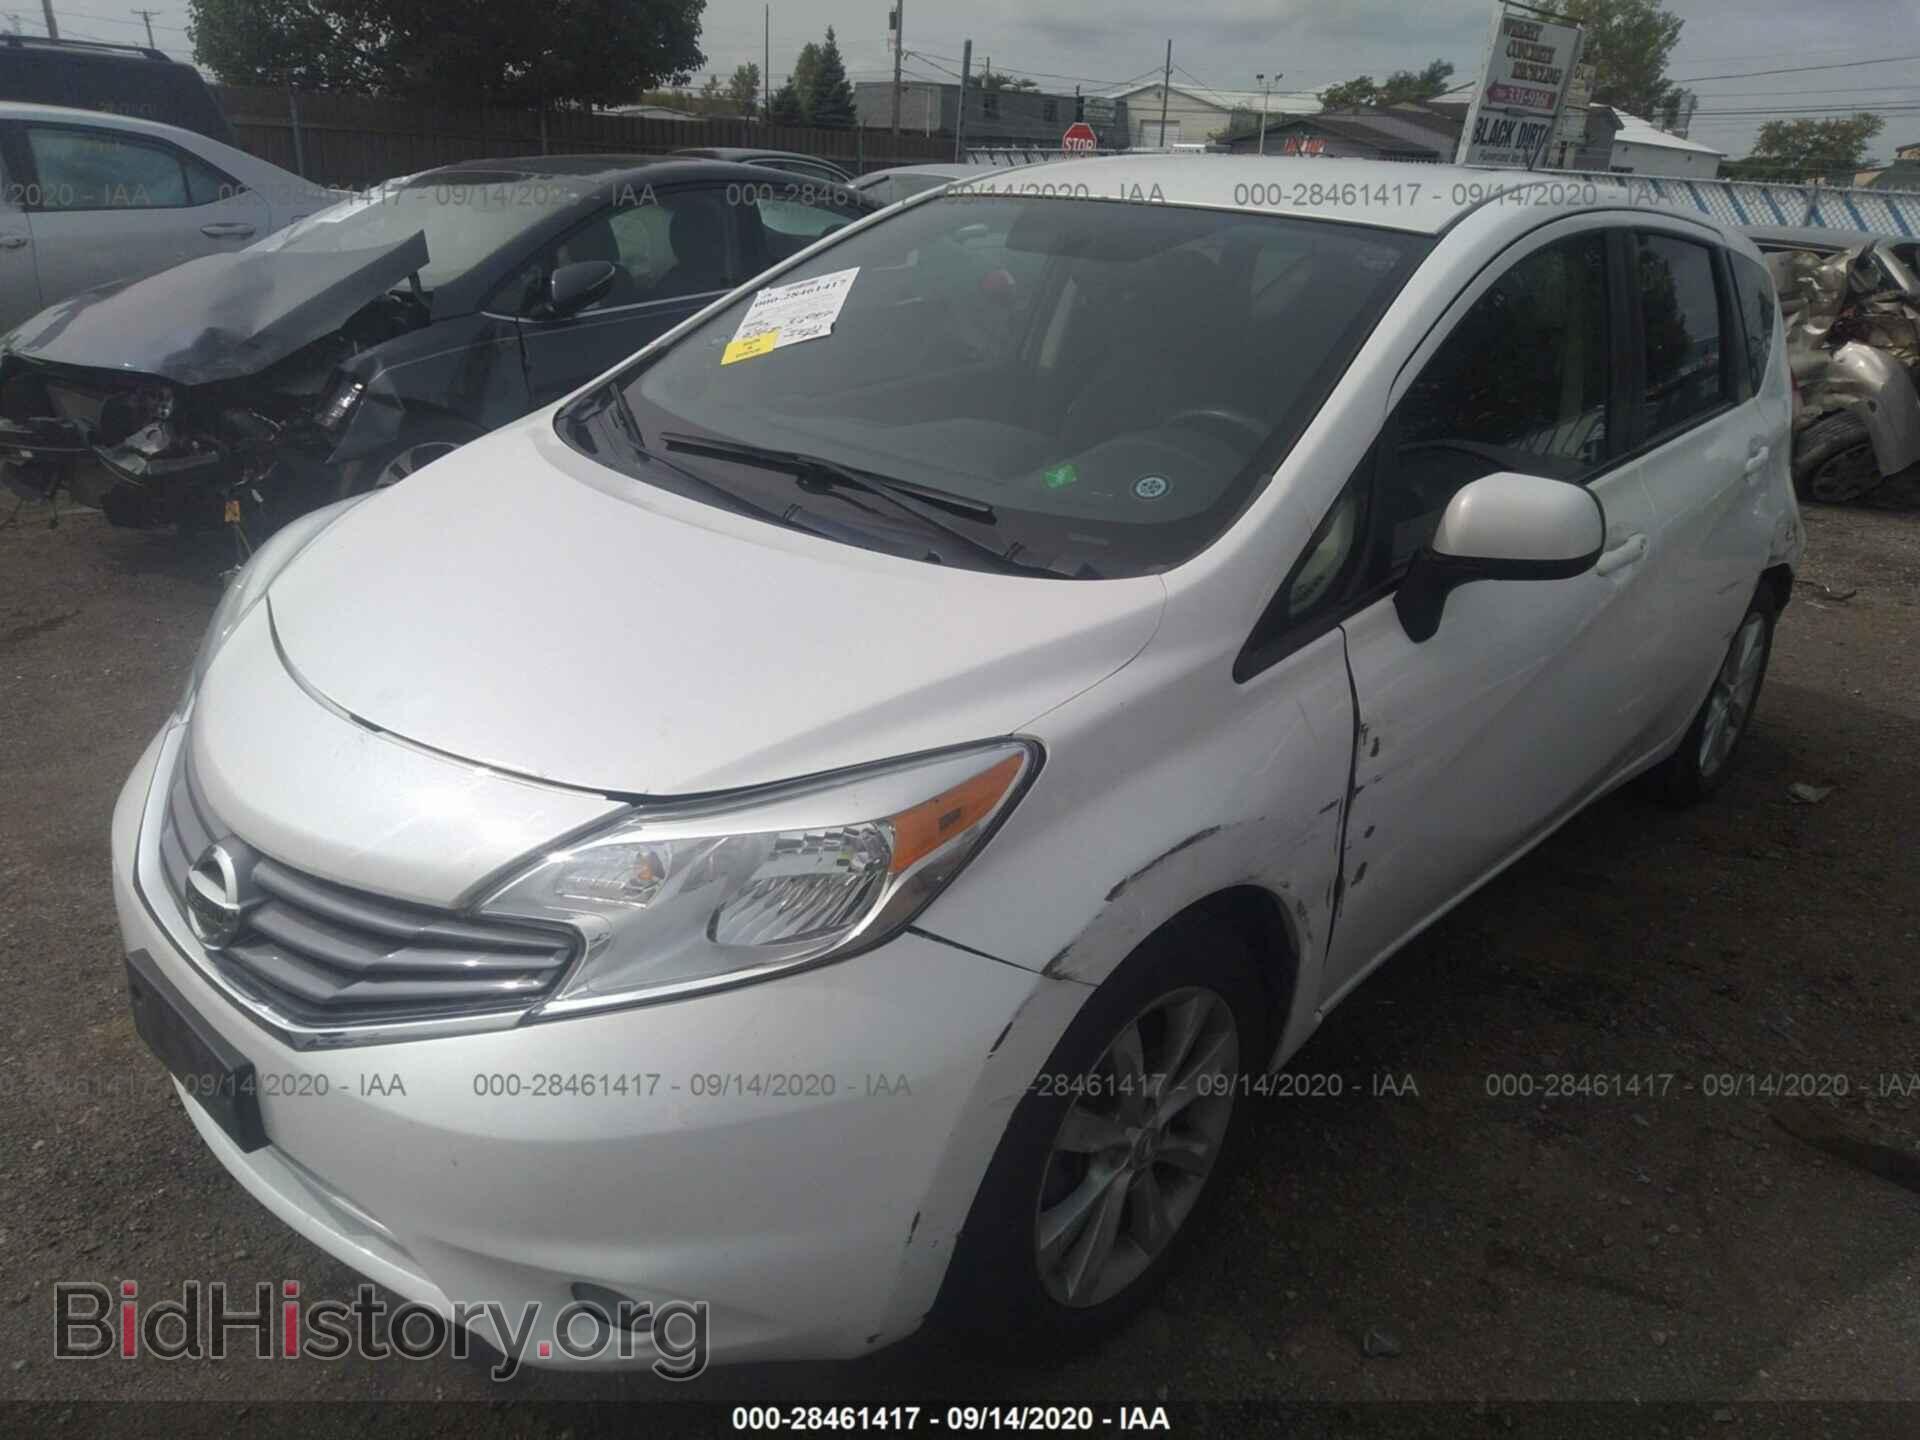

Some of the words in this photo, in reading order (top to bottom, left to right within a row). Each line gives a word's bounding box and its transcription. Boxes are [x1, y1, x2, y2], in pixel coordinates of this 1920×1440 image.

[1065, 137, 1094, 152] STOP
[1473, 117, 1517, 148] BLACK
[1515, 121, 1547, 151] DIRT
